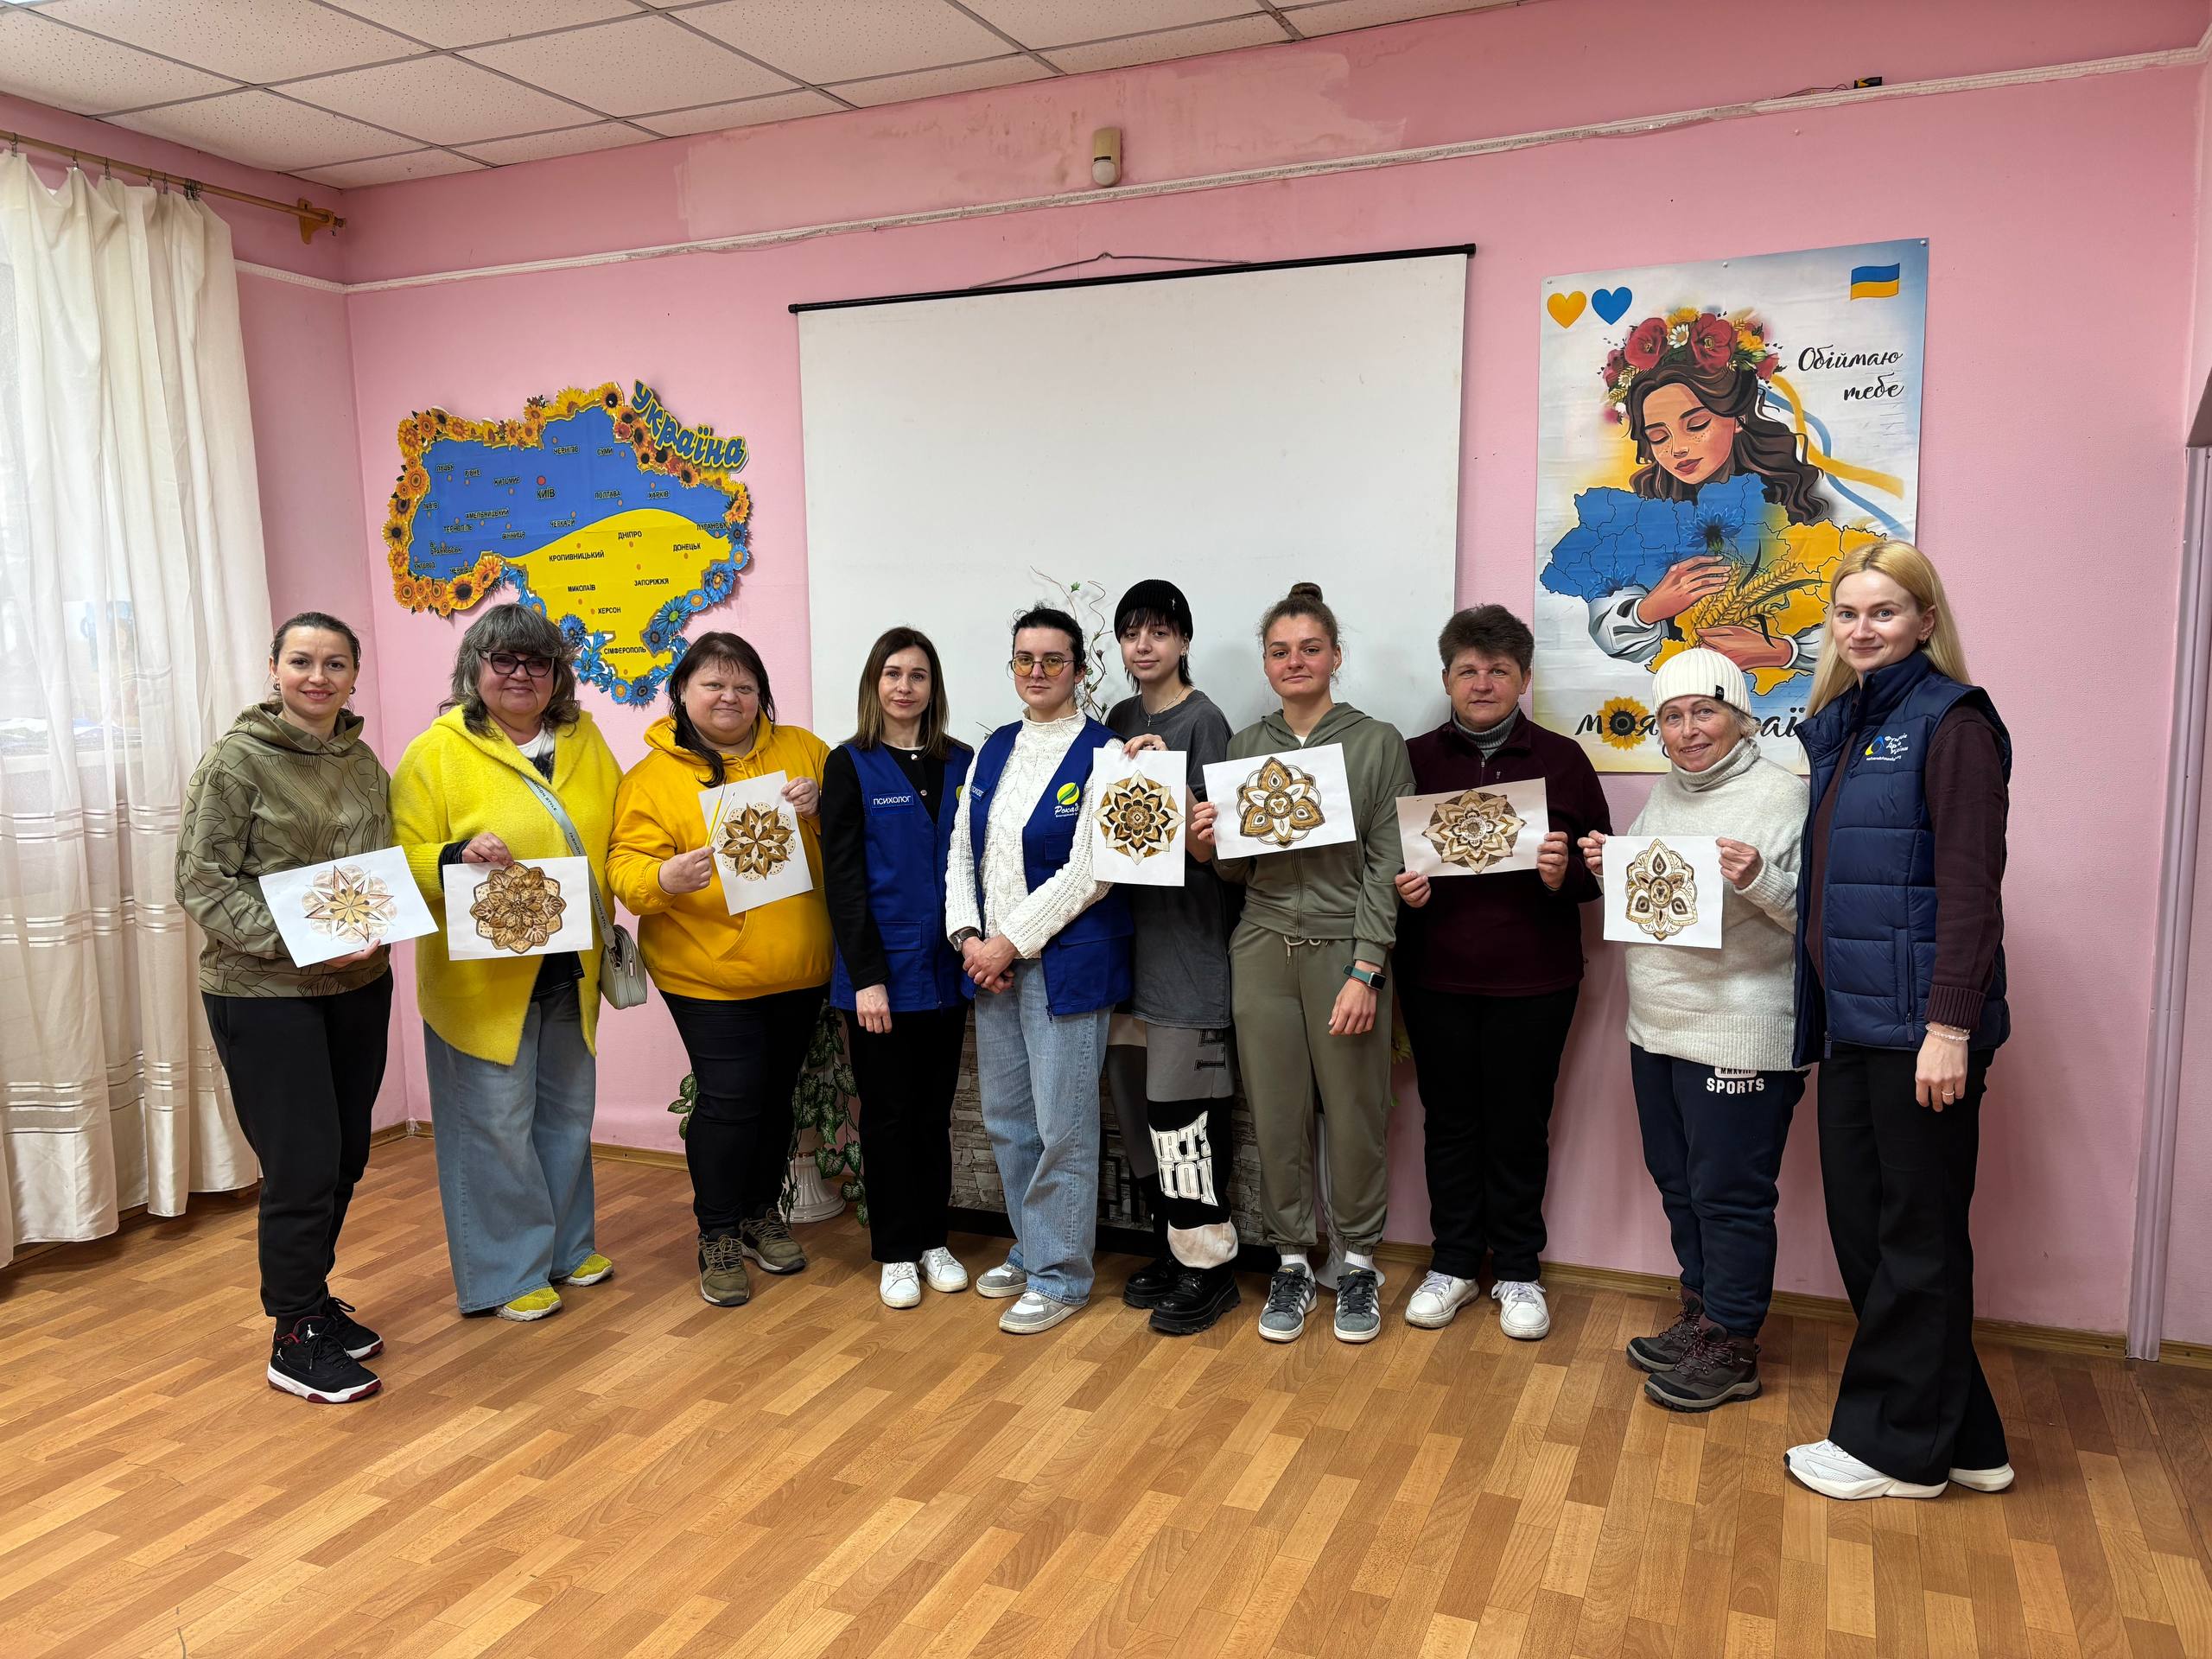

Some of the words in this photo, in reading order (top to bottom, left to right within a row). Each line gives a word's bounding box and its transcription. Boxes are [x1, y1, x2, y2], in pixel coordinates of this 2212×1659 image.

[1798, 344, 1904, 372] Обіймаю
[1843, 372, 1904, 401] тебе
[632, 380, 744, 467] Україна
[537, 487, 556, 499] КИЇВ
[618, 531, 643, 540] ДНІПРО
[672, 543, 702, 552] ДОНЕЦЬК
[549, 550, 605, 562] КРОПИВНИЦЬКИЙ
[568, 584, 596, 593] МИКОЛАЇВ
[634, 578, 670, 587] ЗАПОРІЖЖЯ
[604, 646, 646, 655] СІМФЕРОПОЛЬ
[873, 795, 912, 805] ПСИХОЛОГ
[1054, 803, 1079, 815] Рокад
[1706, 1077, 1764, 1095] SPORTS
